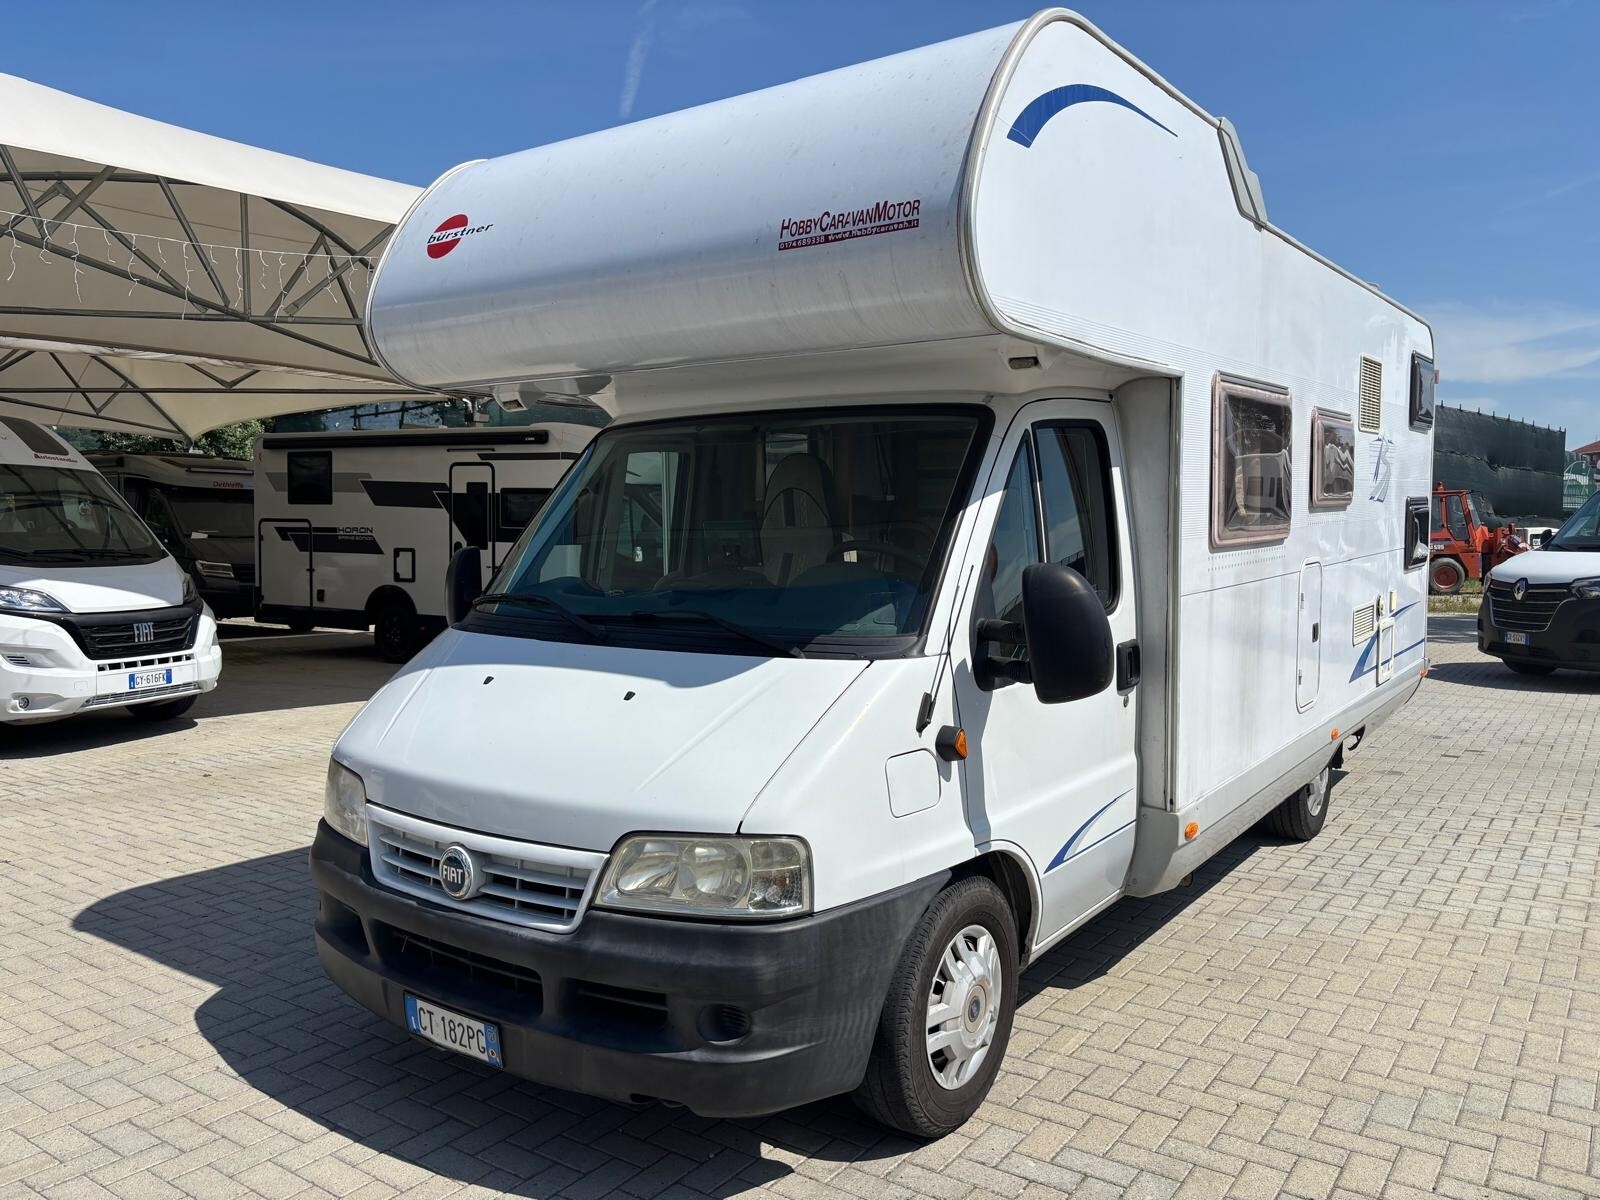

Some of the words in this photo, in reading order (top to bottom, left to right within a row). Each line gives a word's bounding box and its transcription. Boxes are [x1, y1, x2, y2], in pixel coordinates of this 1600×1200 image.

[427, 224, 494, 244] bürstner
[133, 622, 154, 642] FIAT
[443, 864, 463, 884] FIAT
[418, 1007, 434, 1035] CT
[441, 1016, 486, 1054] 182PG
